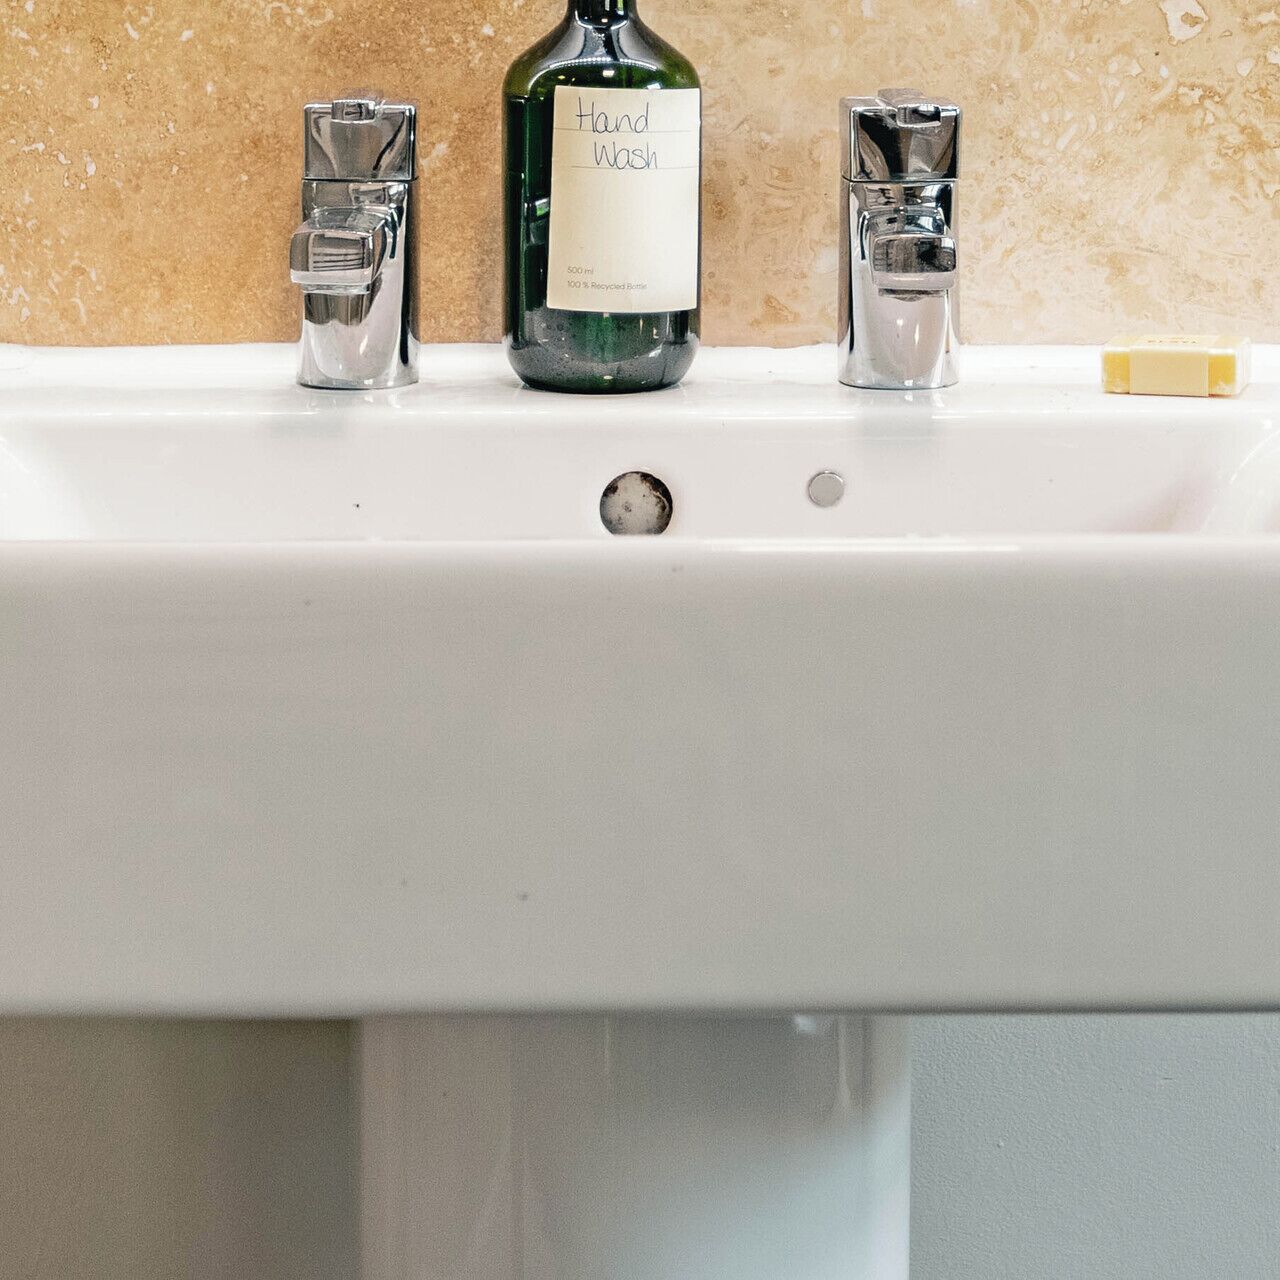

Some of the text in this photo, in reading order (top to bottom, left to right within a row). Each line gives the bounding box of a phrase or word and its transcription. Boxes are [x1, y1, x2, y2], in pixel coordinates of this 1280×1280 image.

[575, 96, 650, 134] Hand
[593, 141, 658, 170] Wash
[567, 266, 593, 275] 500 ml
[567, 280, 581, 288] 100
[591, 281, 625, 291] Recycled
